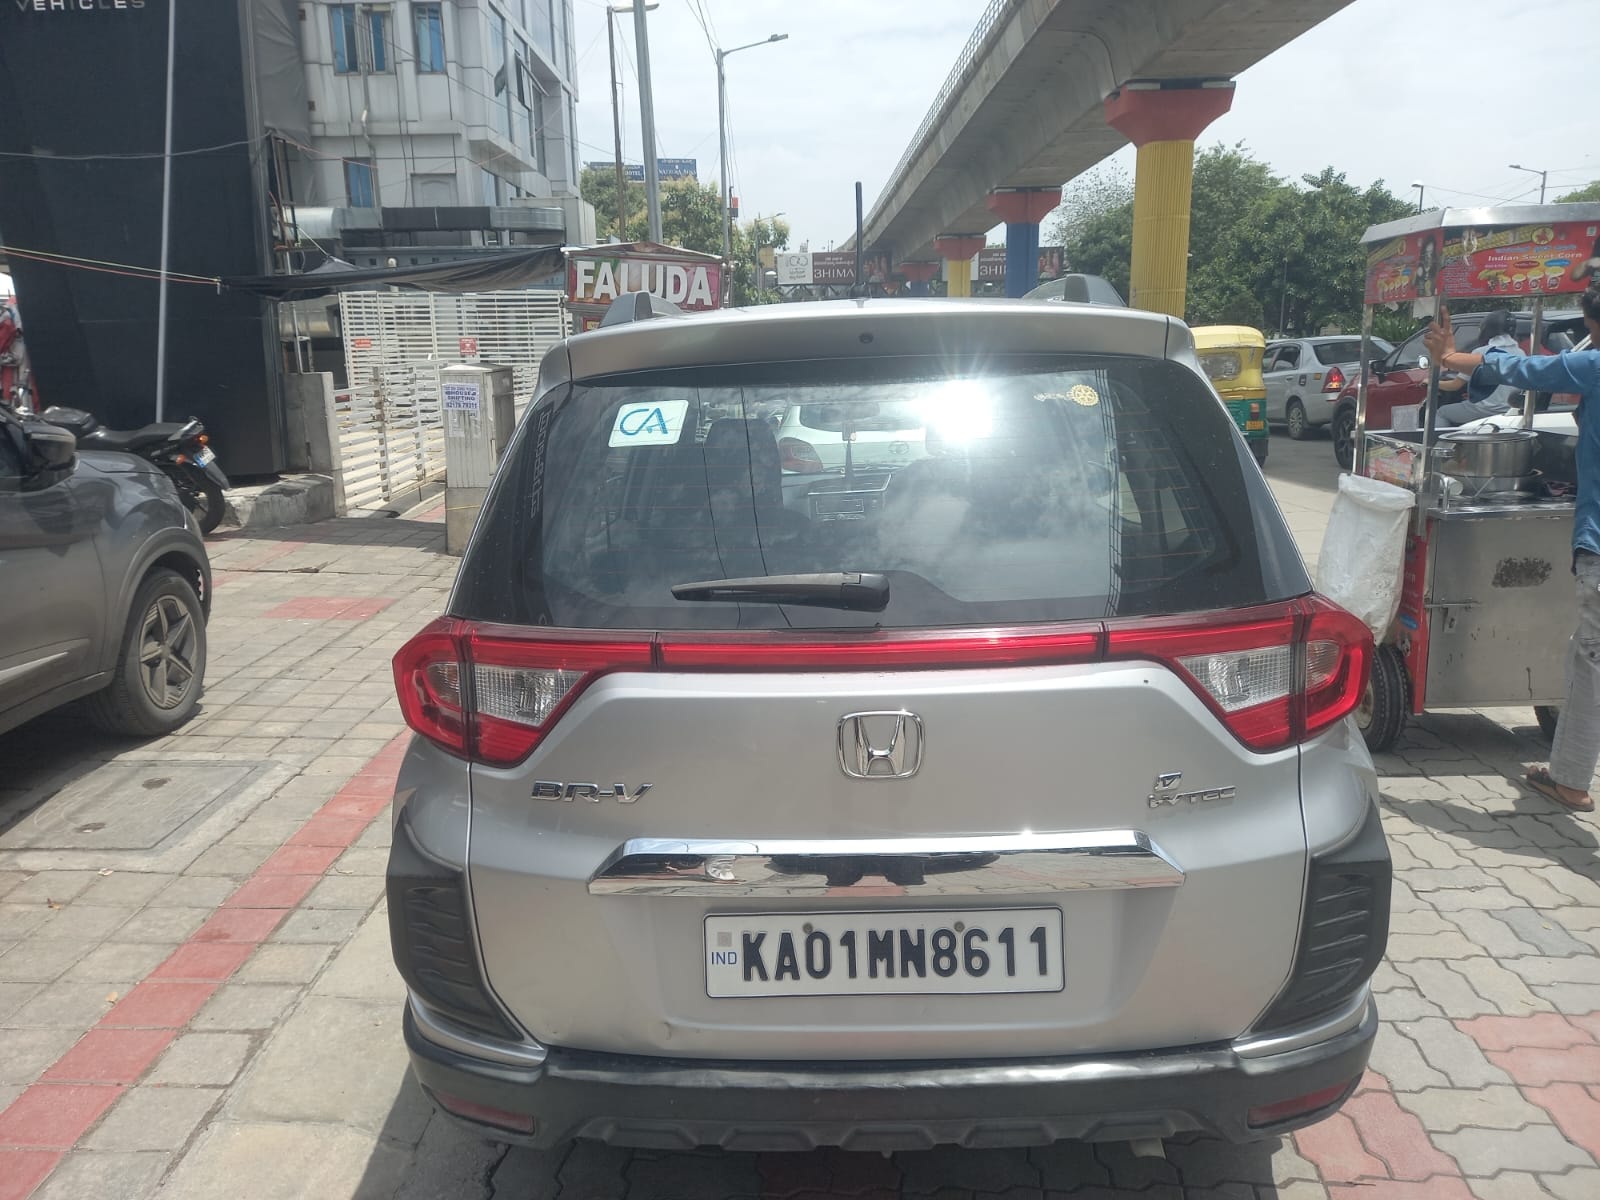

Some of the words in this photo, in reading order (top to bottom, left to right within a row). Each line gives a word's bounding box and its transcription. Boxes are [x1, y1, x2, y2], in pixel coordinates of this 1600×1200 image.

[16, 0, 146, 11] VEHICLES
[1488, 254, 1519, 262] Indian
[576, 260, 713, 306] FALUDA
[531, 780, 654, 804] BR-V
[711, 951, 738, 966] IND
[741, 926, 1048, 982] KA01MN8611
